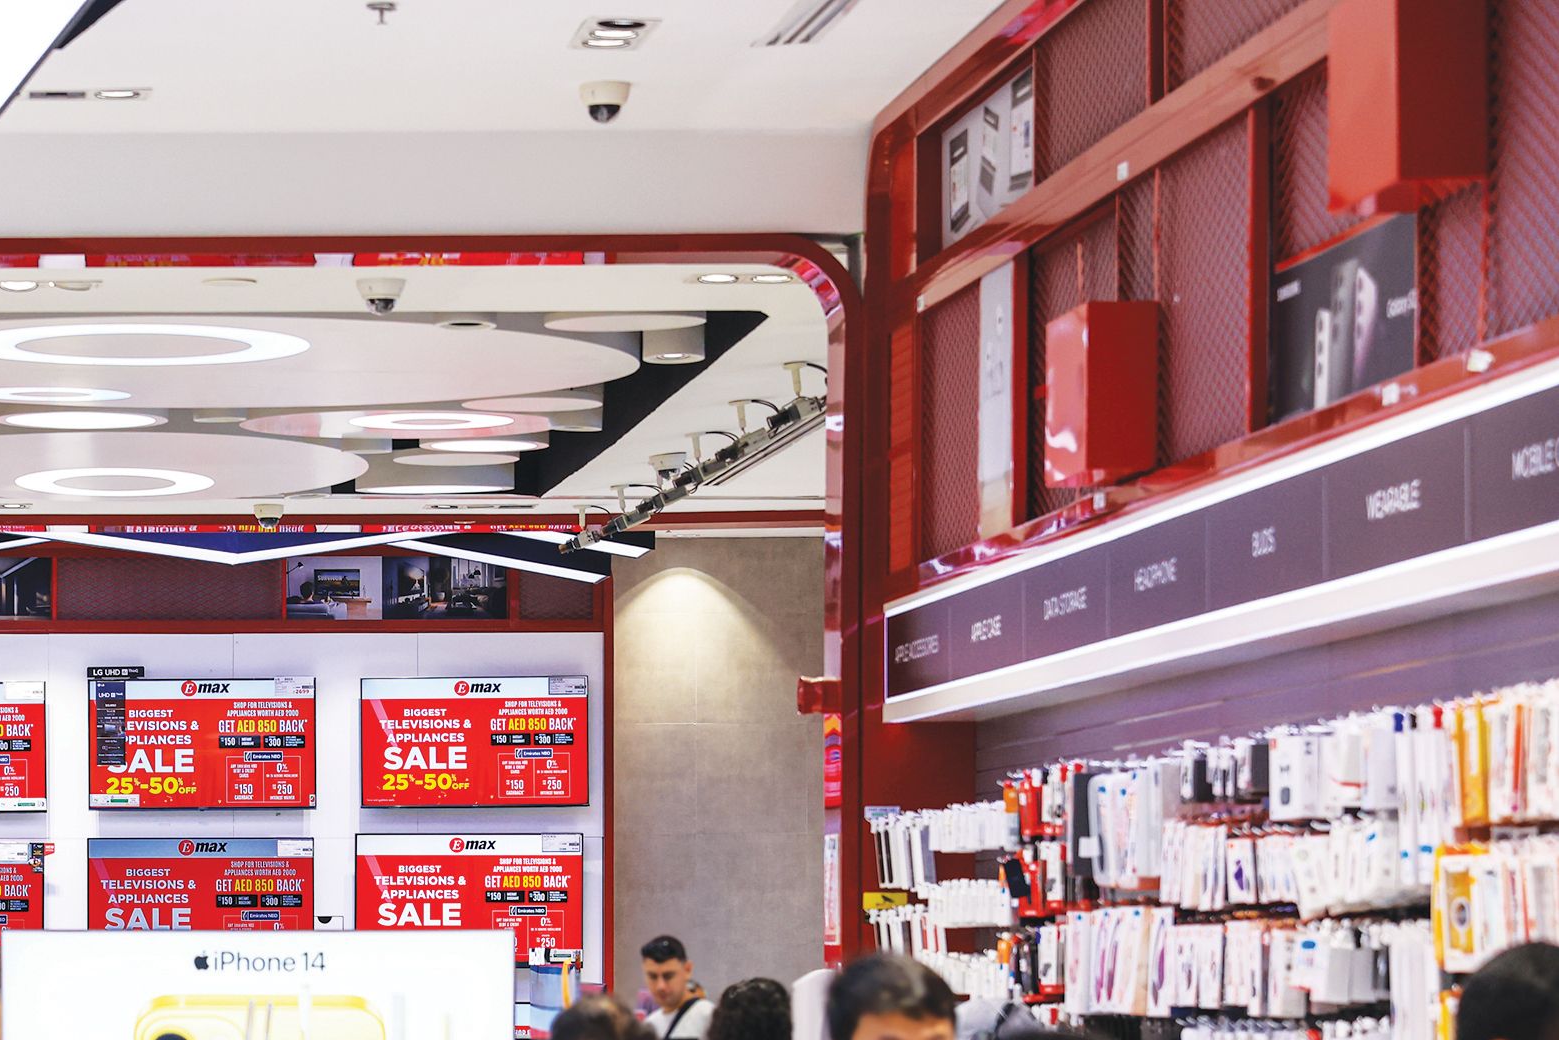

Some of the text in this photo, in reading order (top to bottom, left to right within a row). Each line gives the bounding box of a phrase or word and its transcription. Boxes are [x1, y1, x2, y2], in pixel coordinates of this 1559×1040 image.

[1366, 479, 1422, 520] WEARABLE
[1251, 527, 1276, 557] BUDS
[1134, 557, 1177, 592] HEADPHONE
[128, 710, 173, 718] BIGGEST
[125, 720, 199, 732] EVISIONS &
[219, 720, 235, 733] GET
[237, 720, 255, 733] AED
[258, 720, 276, 733] 850
[379, 720, 472, 729] TELEVISIONS &
[491, 719, 506, 731] GET
[509, 718, 526, 731] AED
[528, 718, 546, 730] 850
[125, 734, 191, 744] PLIANCES
[387, 733, 464, 743] APPLIANCES
[384, 746, 467, 770] SALE
[398, 865, 441, 873] BIGGEST
[101, 880, 196, 889] TELEVISIONS &
[216, 880, 232, 892] GET
[234, 879, 252, 892] AED
[255, 879, 273, 892] 850
[374, 877, 466, 885] TELEVISIONS &
[485, 876, 501, 888] GET
[503, 876, 520, 888] AED
[523, 876, 541, 888] 850
[108, 894, 189, 903] APPLIANCES
[381, 890, 459, 899] APPLIANCES
[105, 908, 191, 930] SALE
[378, 903, 461, 926] SALE
[213, 951, 326, 972] iPhone 14
